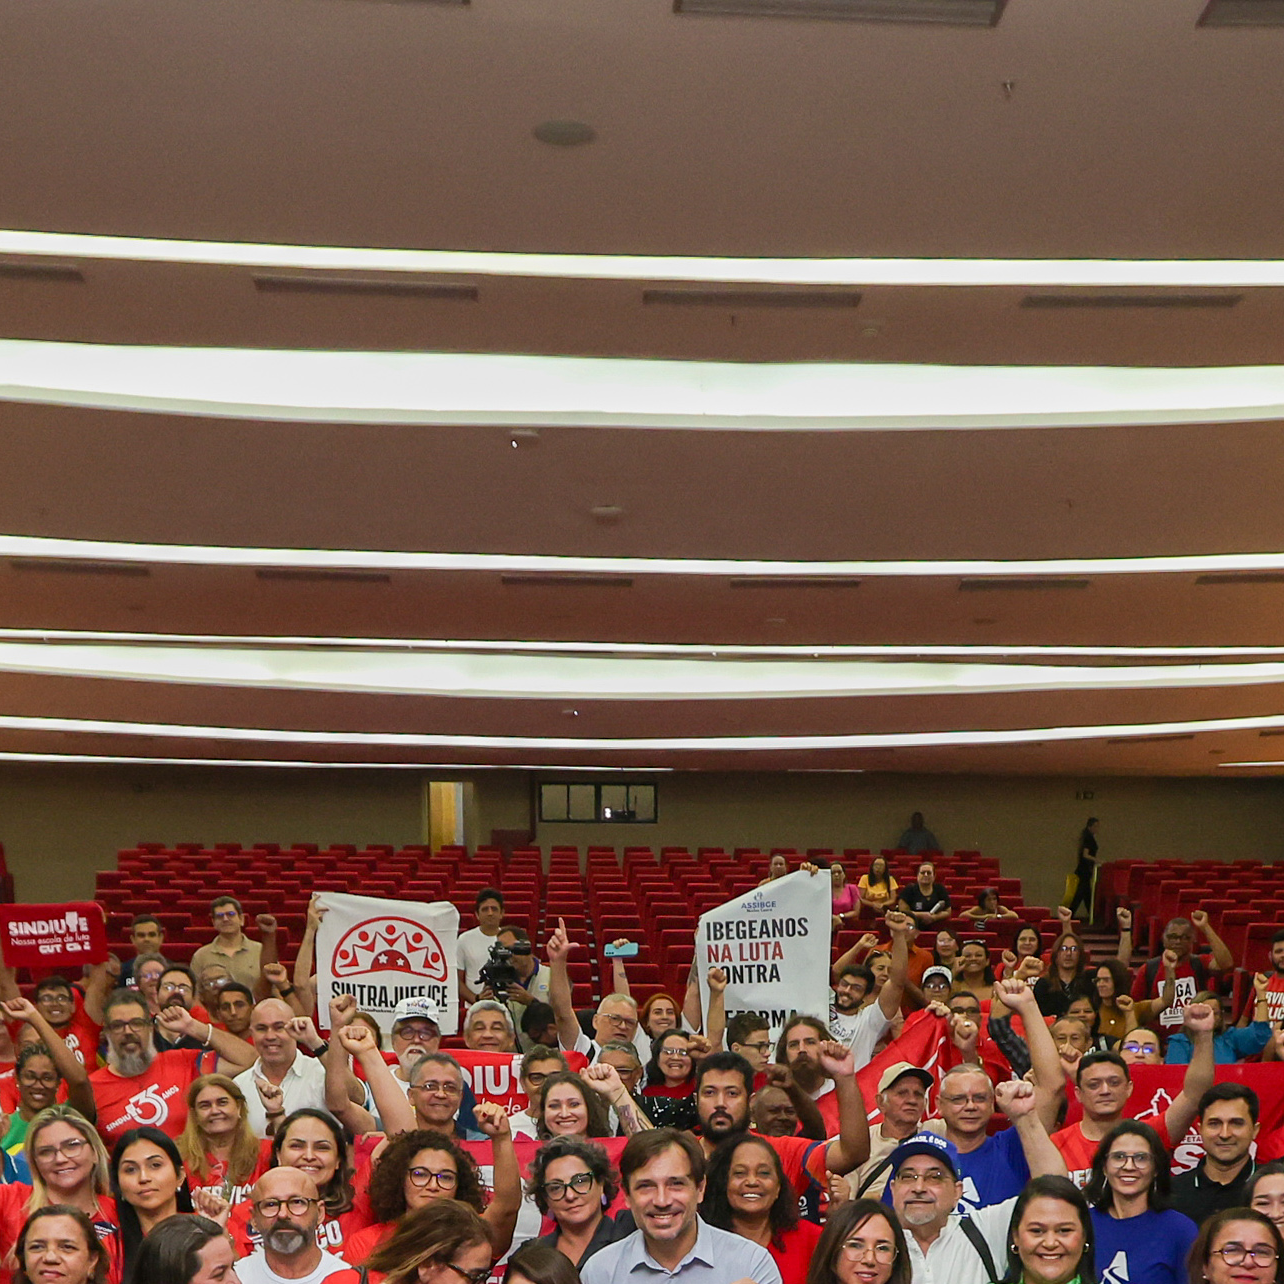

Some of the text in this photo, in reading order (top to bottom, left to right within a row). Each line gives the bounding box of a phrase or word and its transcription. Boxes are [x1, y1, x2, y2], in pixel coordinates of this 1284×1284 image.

[63, 933, 74, 942] de
[705, 917, 809, 941] IBEGEANOS
[707, 941, 784, 963] NA LUTA
